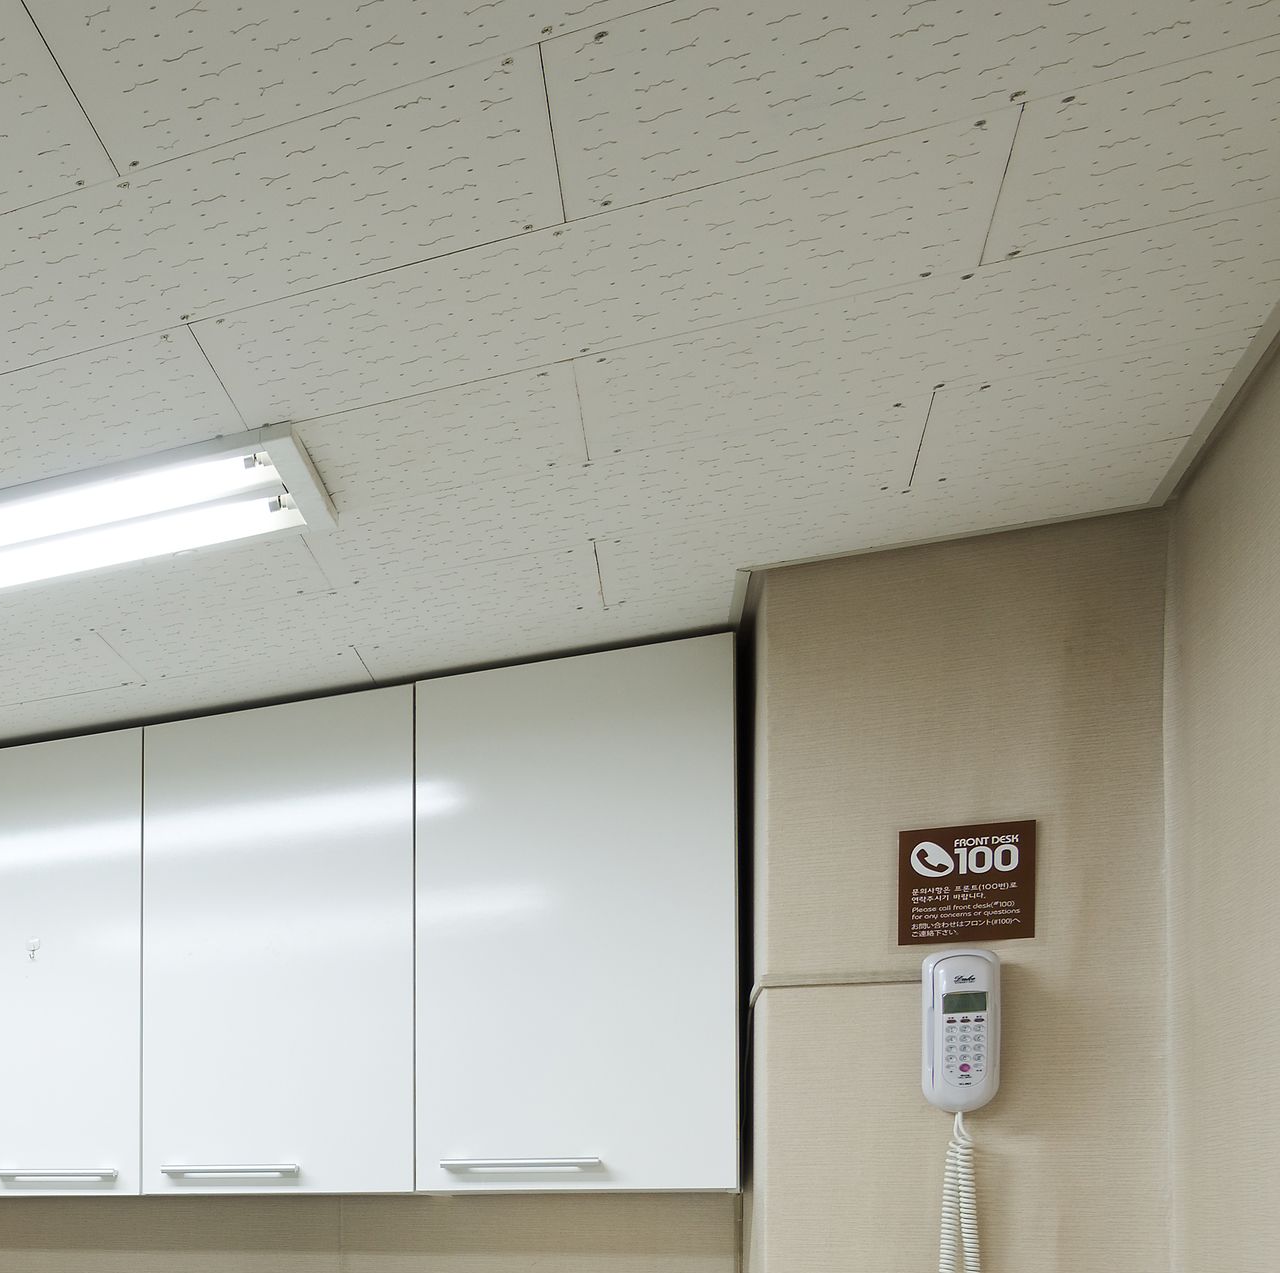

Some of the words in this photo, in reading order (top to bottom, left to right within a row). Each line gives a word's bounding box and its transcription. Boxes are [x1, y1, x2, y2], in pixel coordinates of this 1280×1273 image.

[954, 836, 989, 848] FRONT
[991, 834, 1019, 845] DESK
[954, 844, 1019, 874] 100
[912, 886, 951, 896] 문의사항은
[912, 894, 949, 904] 연락주시기
[983, 908, 1021, 916] questions
